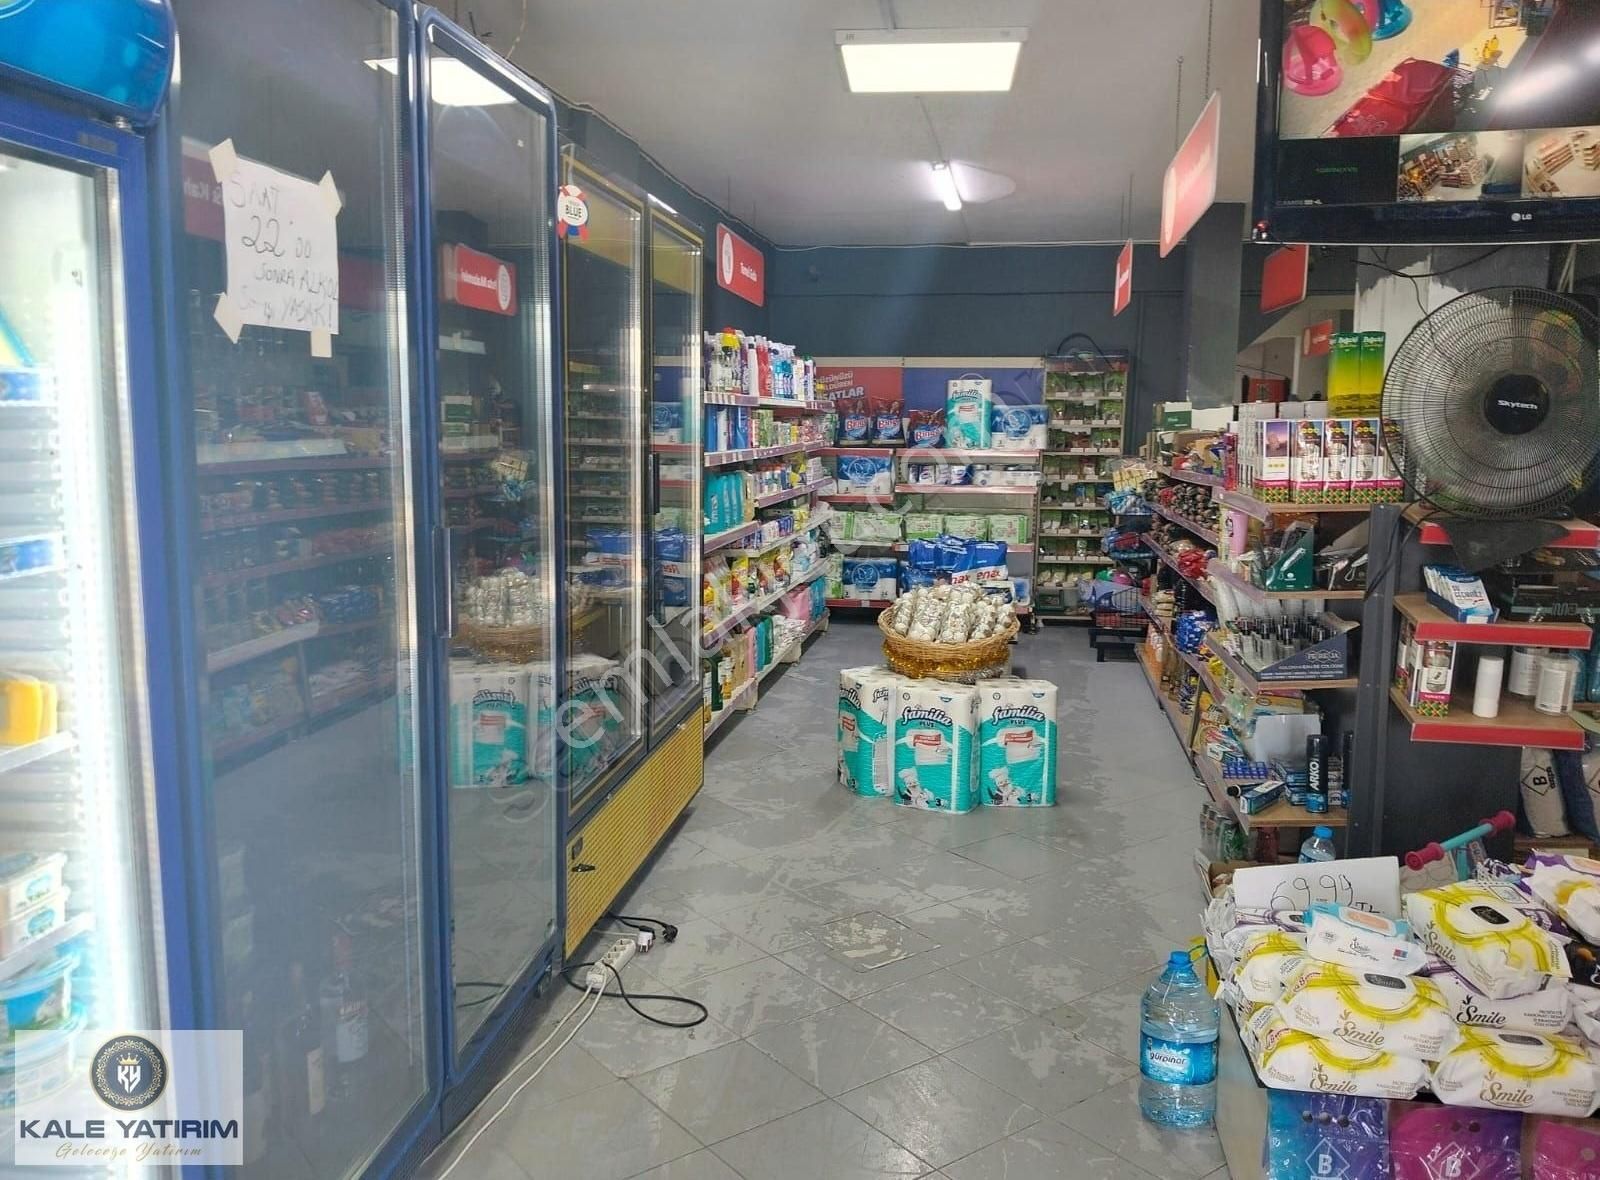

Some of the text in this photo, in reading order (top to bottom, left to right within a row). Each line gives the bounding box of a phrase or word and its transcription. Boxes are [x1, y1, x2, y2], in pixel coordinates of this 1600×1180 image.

[565, 205, 582, 218] BLUE
[1497, 400, 1538, 410] Skytech
[902, 706, 953, 727] familia
[992, 705, 1046, 727] familia
[1309, 762, 1320, 791] ARKO
[1456, 1005, 1507, 1025] Smile
[1332, 1020, 1385, 1047] Smile
[1309, 1073, 1359, 1094] Smile
[1479, 1081, 1535, 1105] Smile
[1318, 1153, 1333, 1175] B
[1445, 1155, 1462, 1178] B
